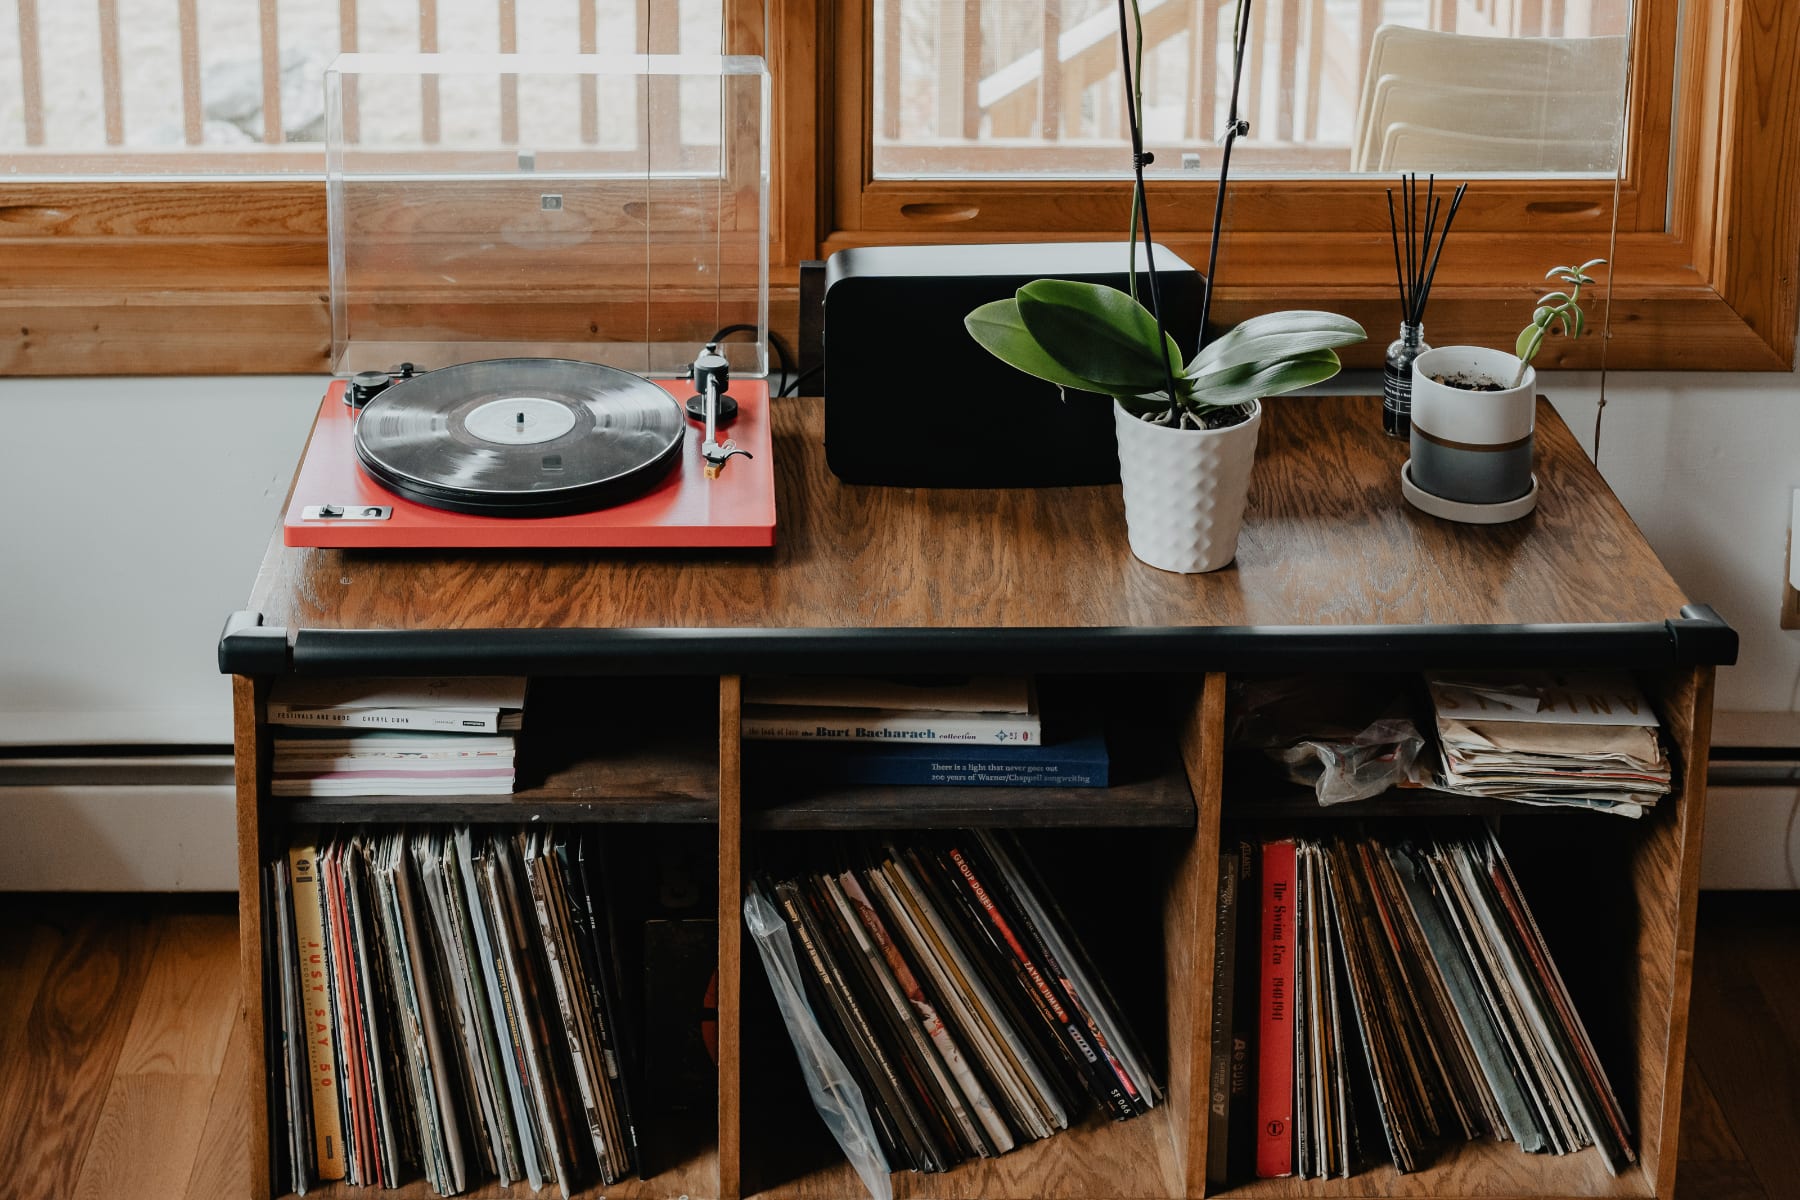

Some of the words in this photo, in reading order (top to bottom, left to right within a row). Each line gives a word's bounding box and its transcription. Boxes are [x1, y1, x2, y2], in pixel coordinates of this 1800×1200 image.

[815, 726, 850, 737] Burt
[855, 727, 936, 739] Bacharach
[938, 732, 977, 740] collection
[931, 763, 952, 771] There
[954, 763, 961, 771] is
[968, 763, 986, 773] light
[988, 763, 1005, 771] that
[946, 775, 967, 783] years
[967, 773, 976, 781] of
[953, 853, 975, 881] GROUP
[971, 881, 995, 911] DOUEH
[1273, 881, 1287, 901] The
[1271, 905, 1287, 941] Swing
[307, 940, 324, 992] JUST
[1271, 944, 1286, 965] Era
[1023, 960, 1046, 988] ZAYNA
[1040, 988, 1065, 1018] JUMMA
[314, 1008, 329, 1047] SAY
[319, 1063, 332, 1087] 50
[1110, 1088, 1121, 1099] SF
[1117, 1098, 1132, 1114] 066
